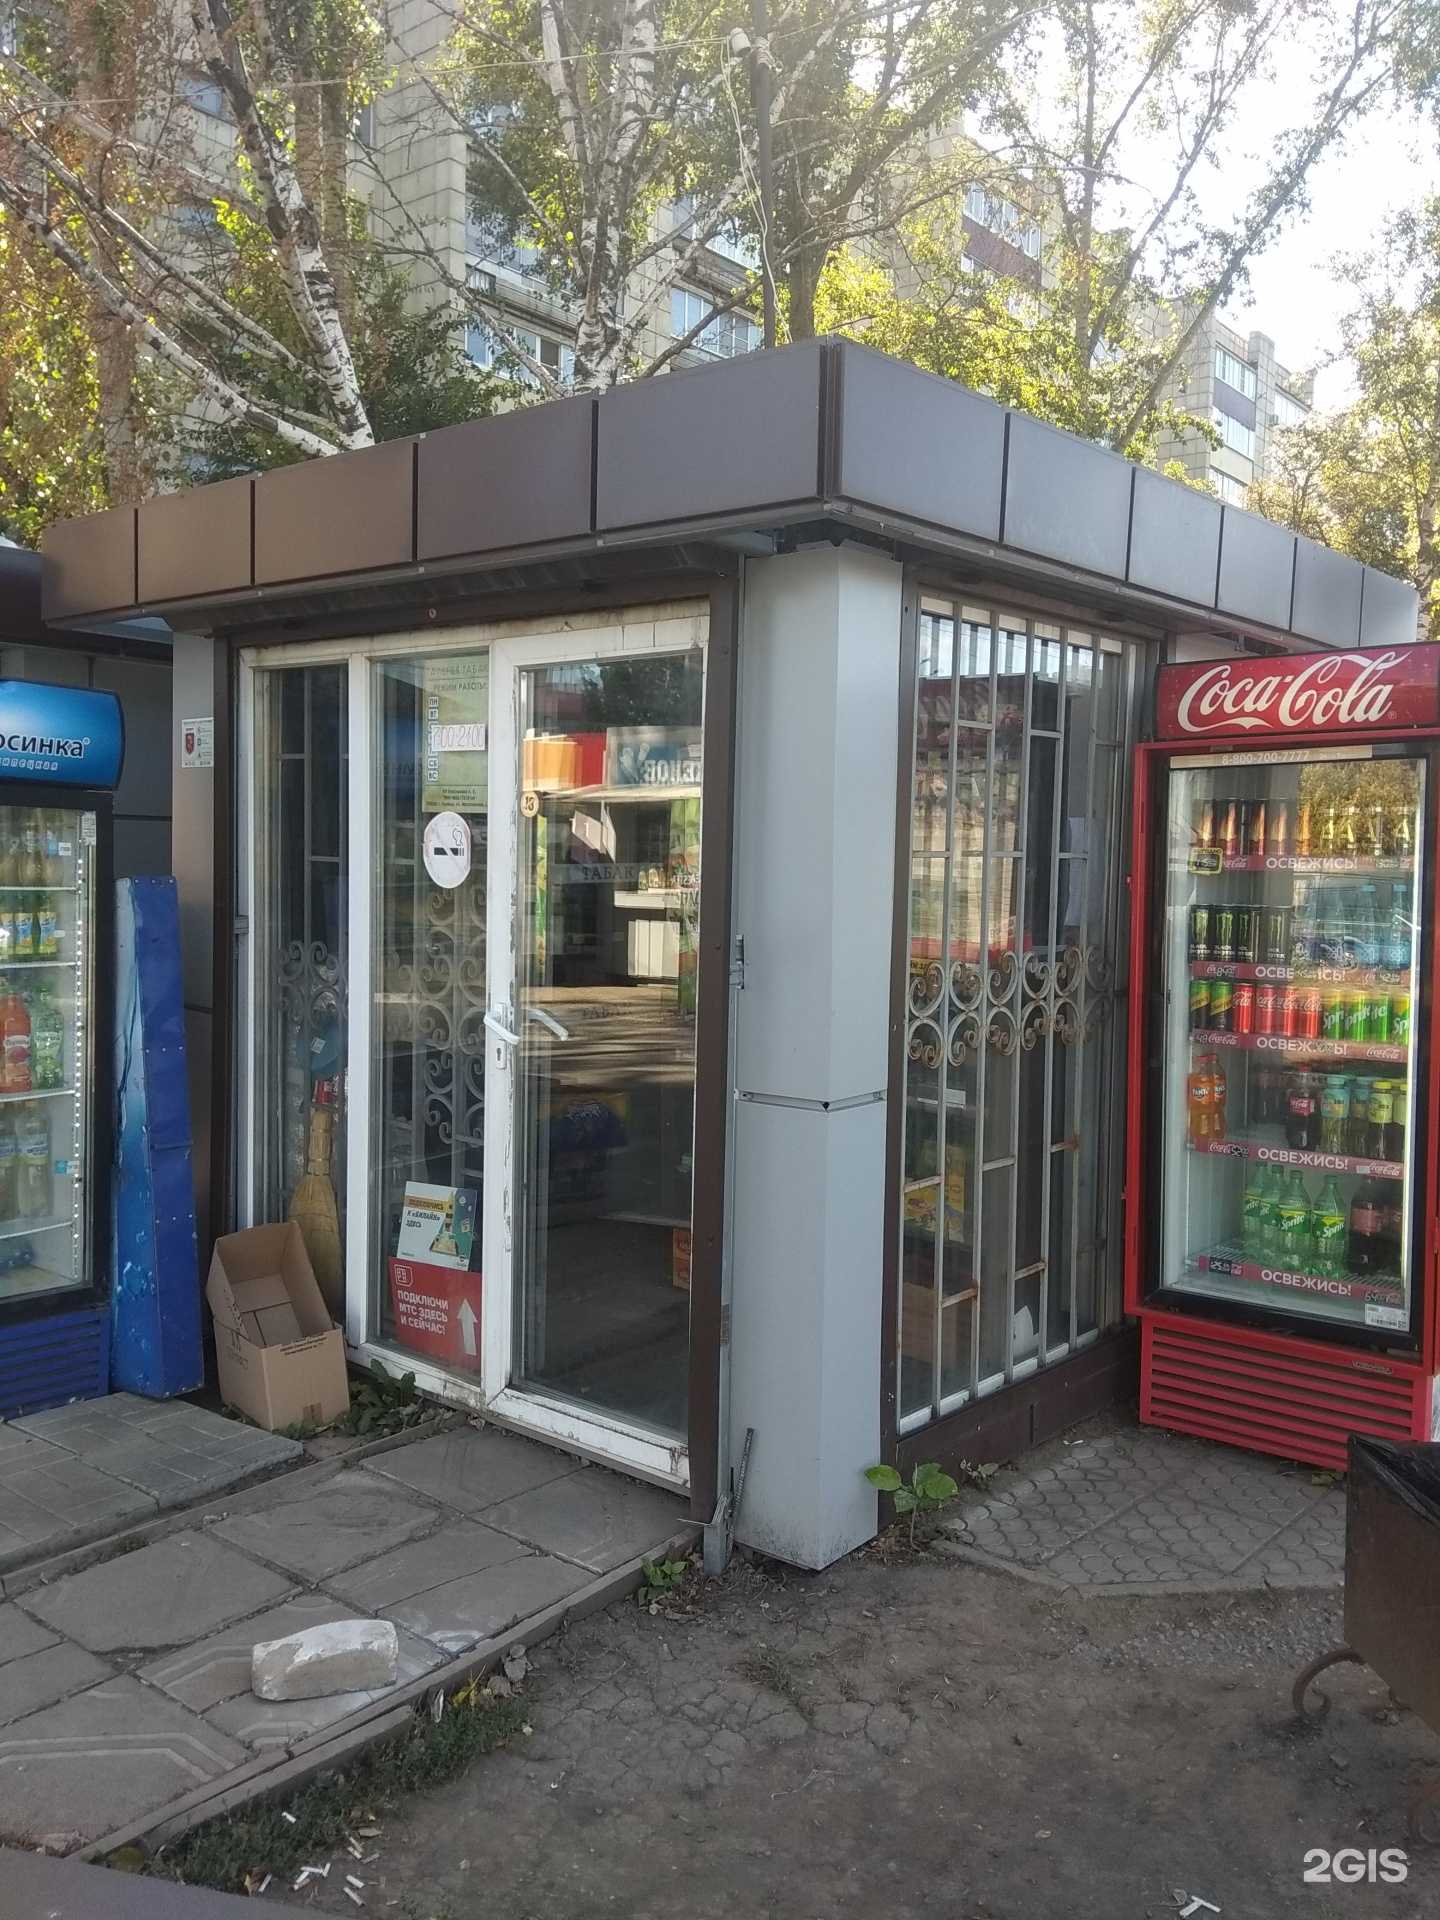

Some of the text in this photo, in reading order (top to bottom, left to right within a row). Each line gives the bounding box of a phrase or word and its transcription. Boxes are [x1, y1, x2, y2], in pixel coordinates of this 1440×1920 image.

[1178, 651, 1412, 732] Coca-Cola
[1266, 856, 1357, 869] ОСВЕЖИСЬ!
[1255, 965, 1345, 981] ОСВЕСЬ!
[1258, 1147, 1349, 1170] ОСВЕЖИСЬ!
[1261, 1269, 1351, 1297] ОСВЕЖИСЬ!
[397, 1290, 449, 1310] ПОДКЛЮЧИ
[399, 1303, 448, 1322] МТС ЗДЕСЬ
[400, 1315, 446, 1336] И СЕЙЧАС!
